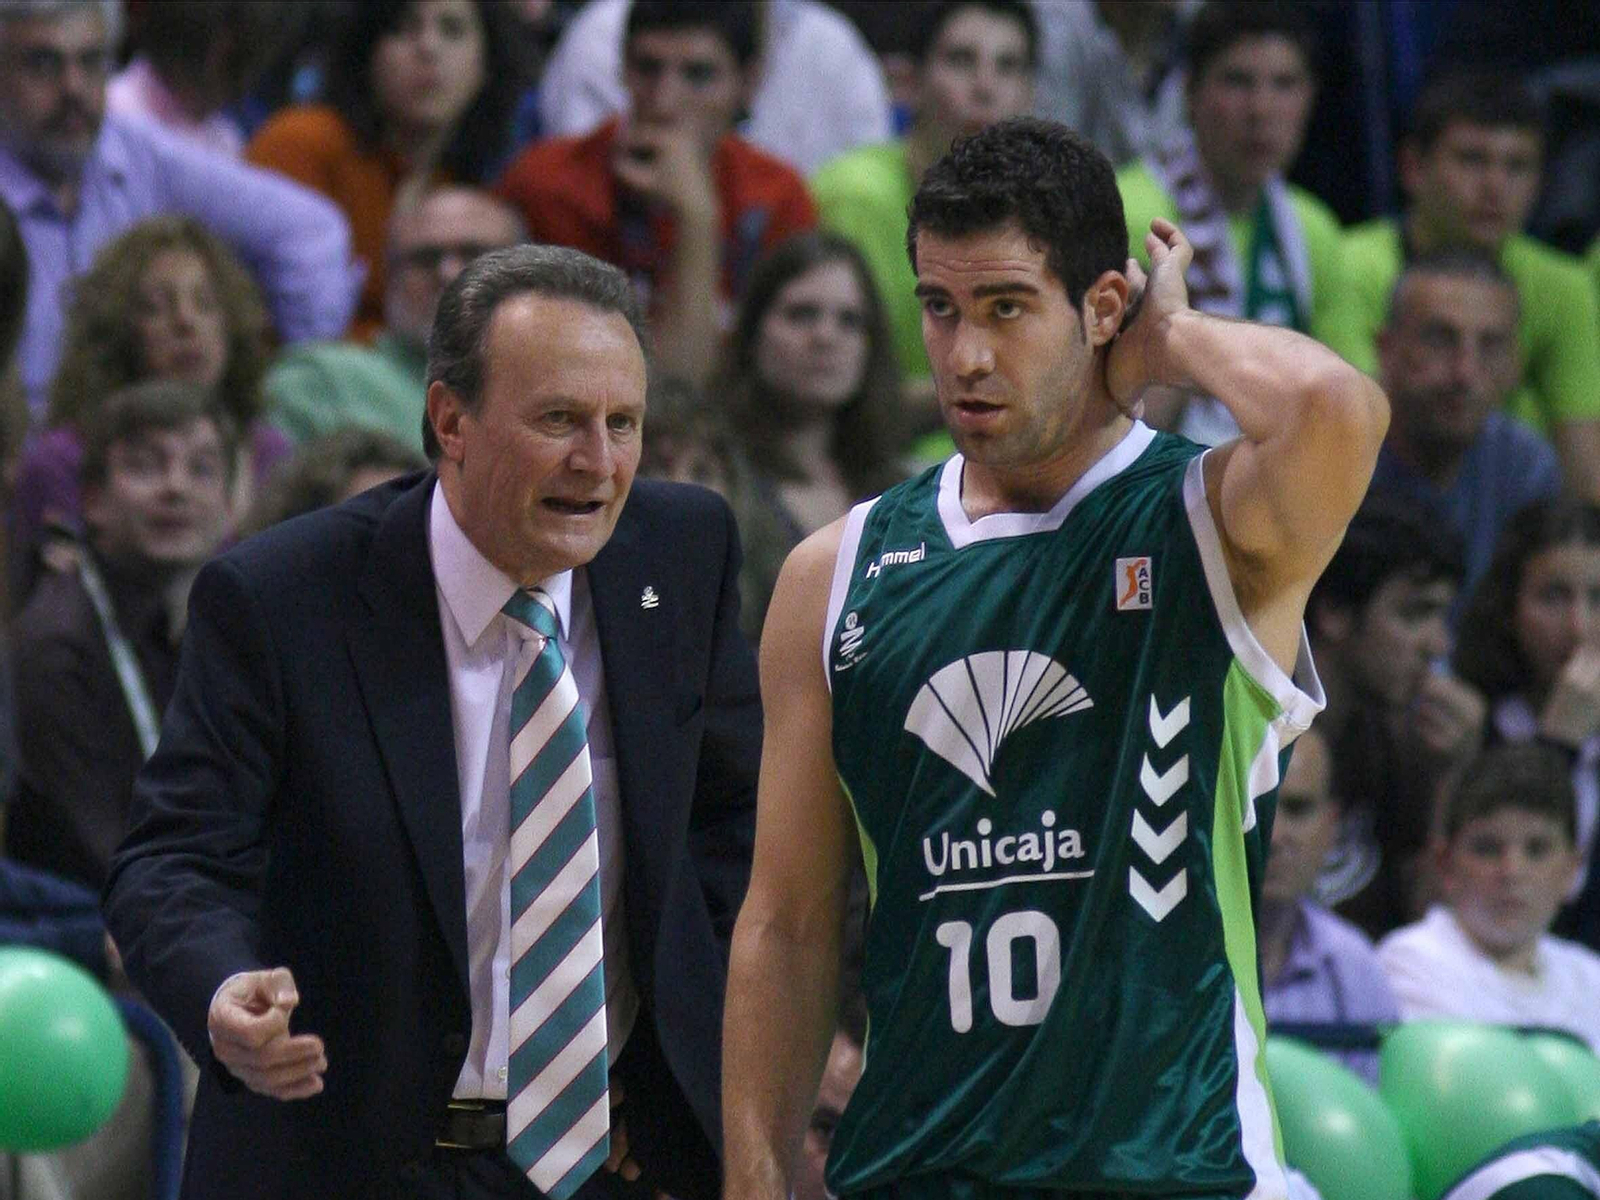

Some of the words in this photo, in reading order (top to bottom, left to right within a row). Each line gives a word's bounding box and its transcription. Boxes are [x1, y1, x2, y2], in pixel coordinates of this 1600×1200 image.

[865, 541, 926, 579] hmmel
[1138, 567, 1150, 605] ACB
[923, 810, 1085, 876] Unicaja
[936, 910, 1061, 1033] 10
